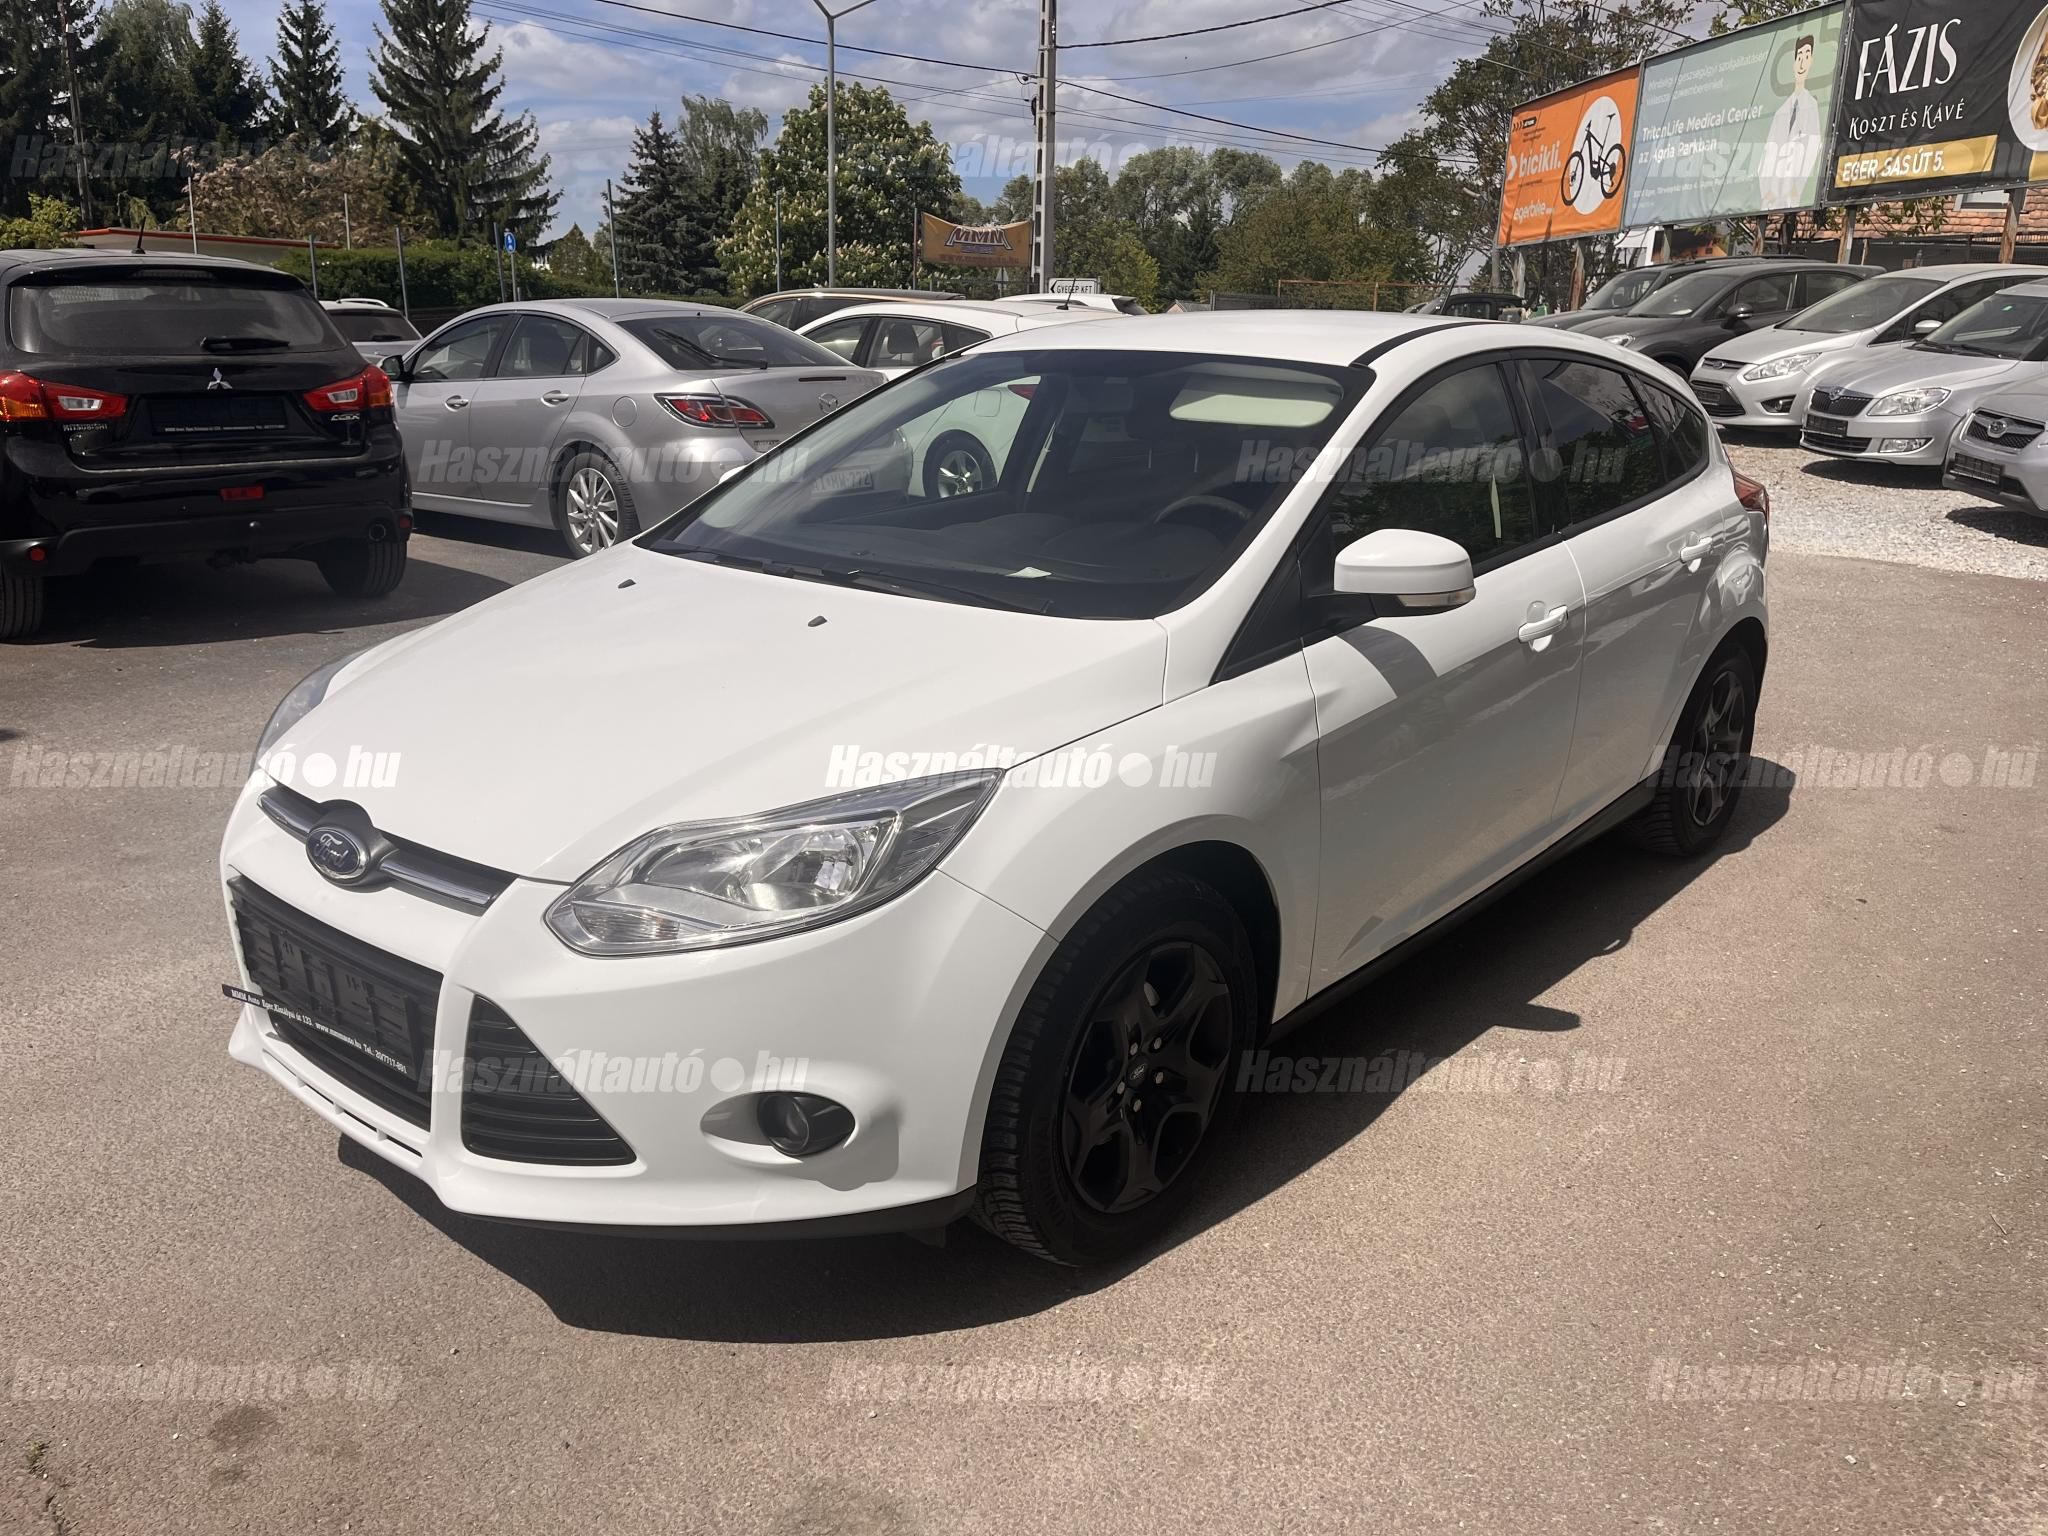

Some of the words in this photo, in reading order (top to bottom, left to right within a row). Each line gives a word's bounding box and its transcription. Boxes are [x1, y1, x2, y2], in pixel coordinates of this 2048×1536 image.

[1854, 18, 1962, 101] FÁZIS
[1686, 109, 1725, 132] Medical
[1848, 114, 1897, 141] KOSZT
[1900, 108, 1918, 129] ÉS
[1921, 98, 1965, 130] KÁVÉ
[1519, 140, 1562, 178] bicikli.
[1679, 136, 1718, 156] Parkban
[1881, 154, 1912, 177] SAS
[1912, 148, 1933, 174] ÚT
[1933, 150, 1945, 172] 5.
[313, 832, 349, 868] Ford
